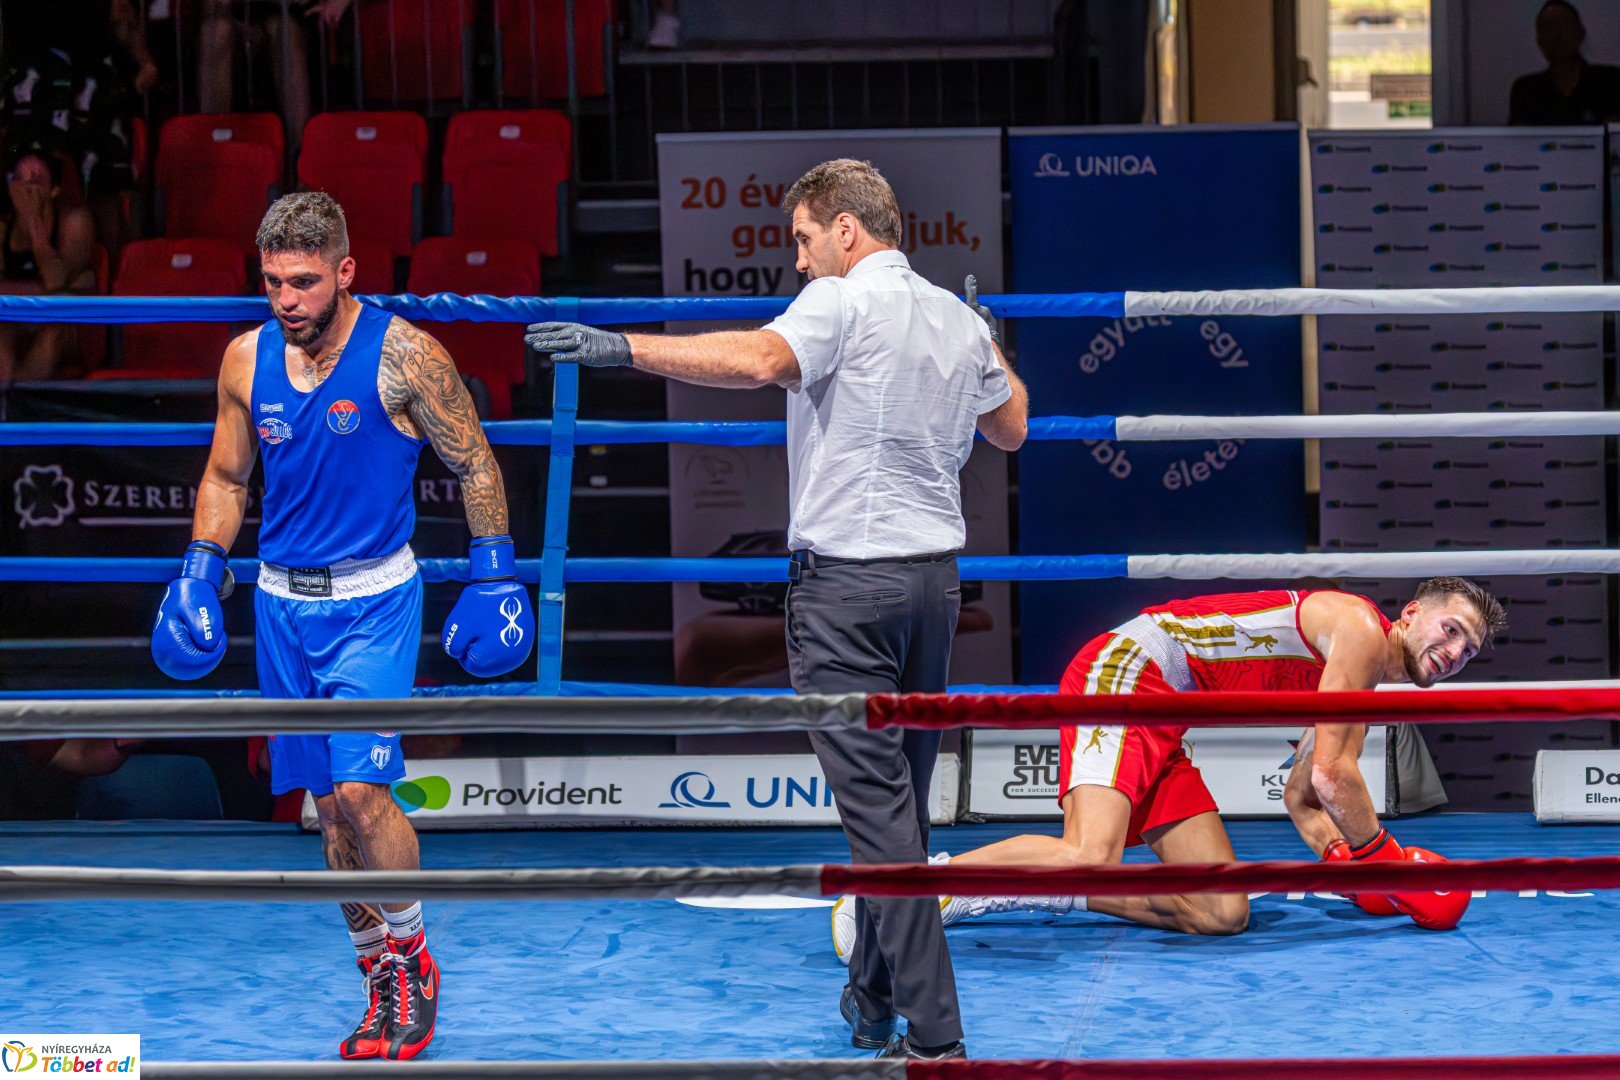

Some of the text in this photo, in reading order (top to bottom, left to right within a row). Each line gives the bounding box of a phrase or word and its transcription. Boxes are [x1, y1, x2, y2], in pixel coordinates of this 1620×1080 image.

[1076, 155, 1158, 177] UNIQA
[681, 173, 786, 210] 20 év
[684, 258, 784, 297] hogy
[1200, 319, 1249, 369] egy
[83, 480, 197, 509] SZERE
[198, 606, 213, 641] STING
[462, 777, 832, 809] Provident UNI
[1586, 793, 1620, 803] Ellen
